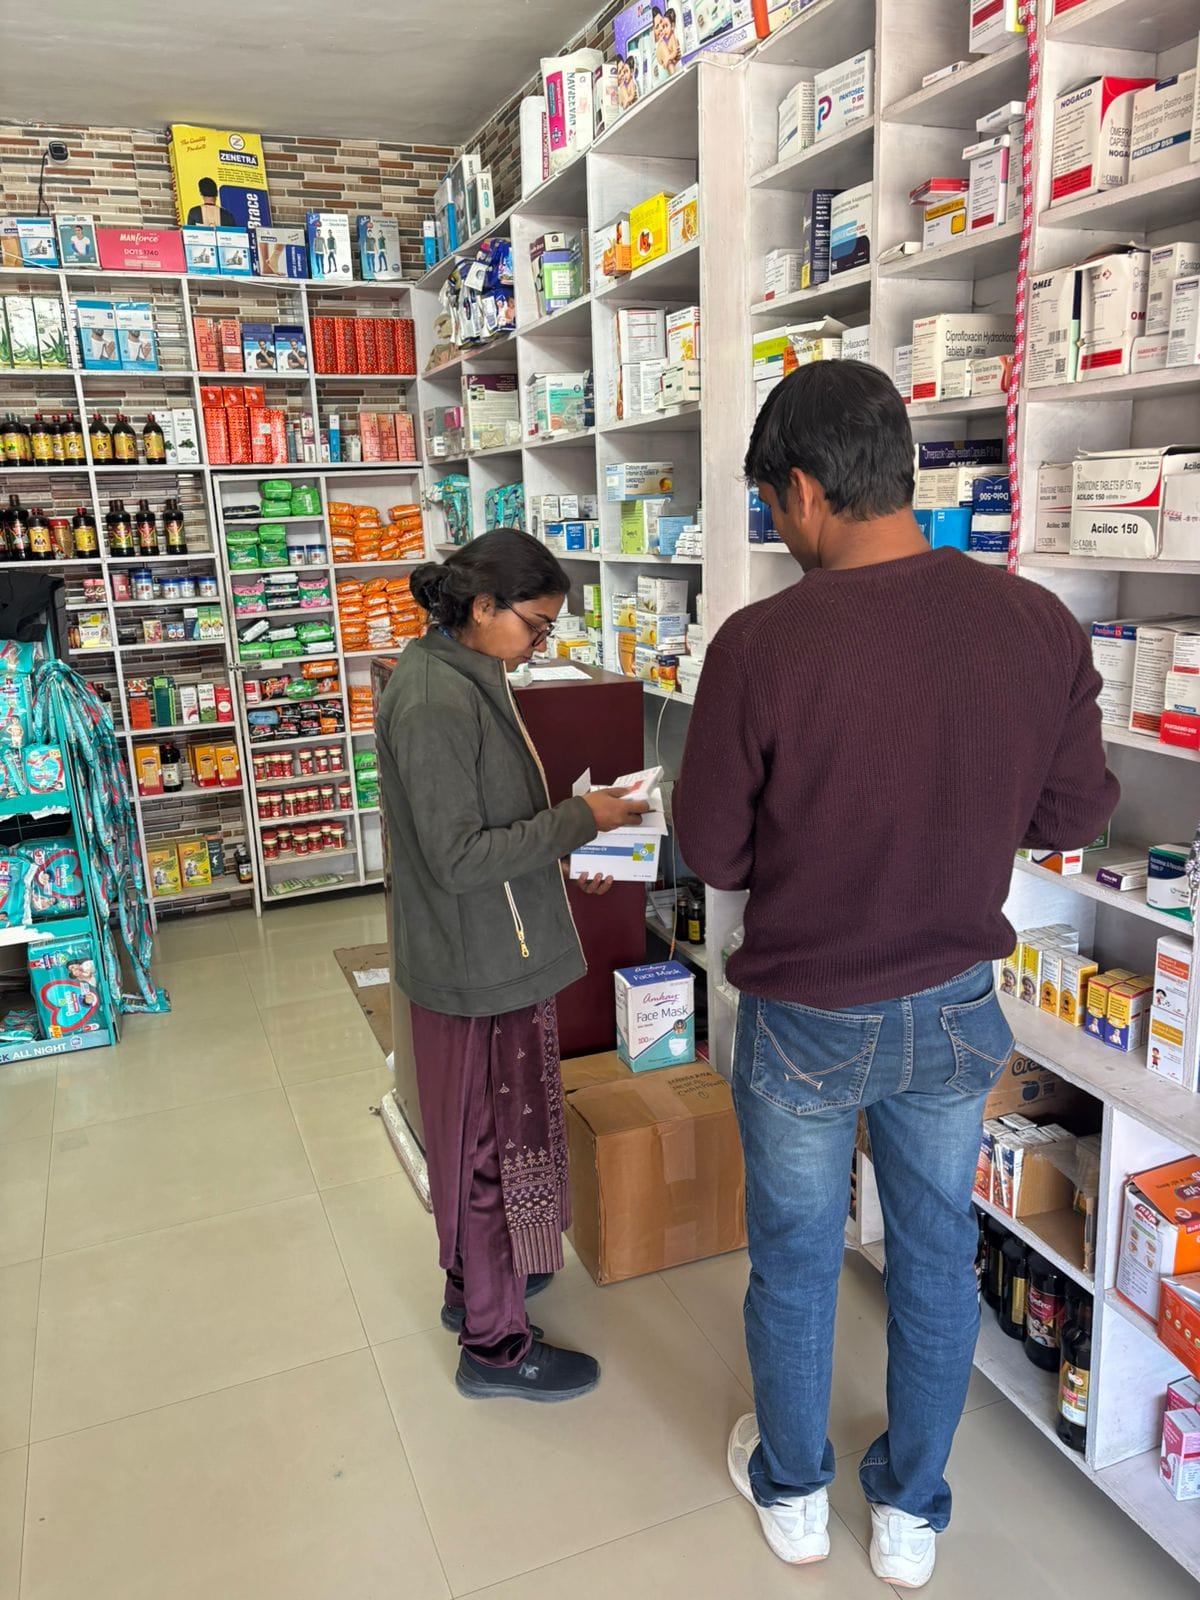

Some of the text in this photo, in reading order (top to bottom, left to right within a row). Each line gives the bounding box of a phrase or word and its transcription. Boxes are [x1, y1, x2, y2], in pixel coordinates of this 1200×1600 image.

[839, 86, 865, 102] PANTOSEC
[1060, 88, 1093, 109] NOGACID
[220, 151, 258, 166] ZENETRA
[246, 192, 262, 230] Brace
[119, 232, 160, 245] MANforce
[1032, 277, 1053, 292] OMEE
[945, 329, 982, 347] Ciprofloxacin
[946, 345, 966, 357] Tablets
[966, 346, 973, 357] IP
[1100, 480, 1119, 491] TABLETS
[1076, 493, 1105, 501] ACILOC 150
[1046, 521, 1061, 532] Aciloc
[1091, 522, 1139, 534] Aciloc 150
[633, 968, 683, 981] Face Mask
[636, 1005, 689, 1023] Face Mask
[637, 1036, 649, 1044] 100
[13, 1049, 32, 1061] ALL
[33, 1043, 67, 1055] NIGHT
[1012, 1057, 1038, 1077] Ora
